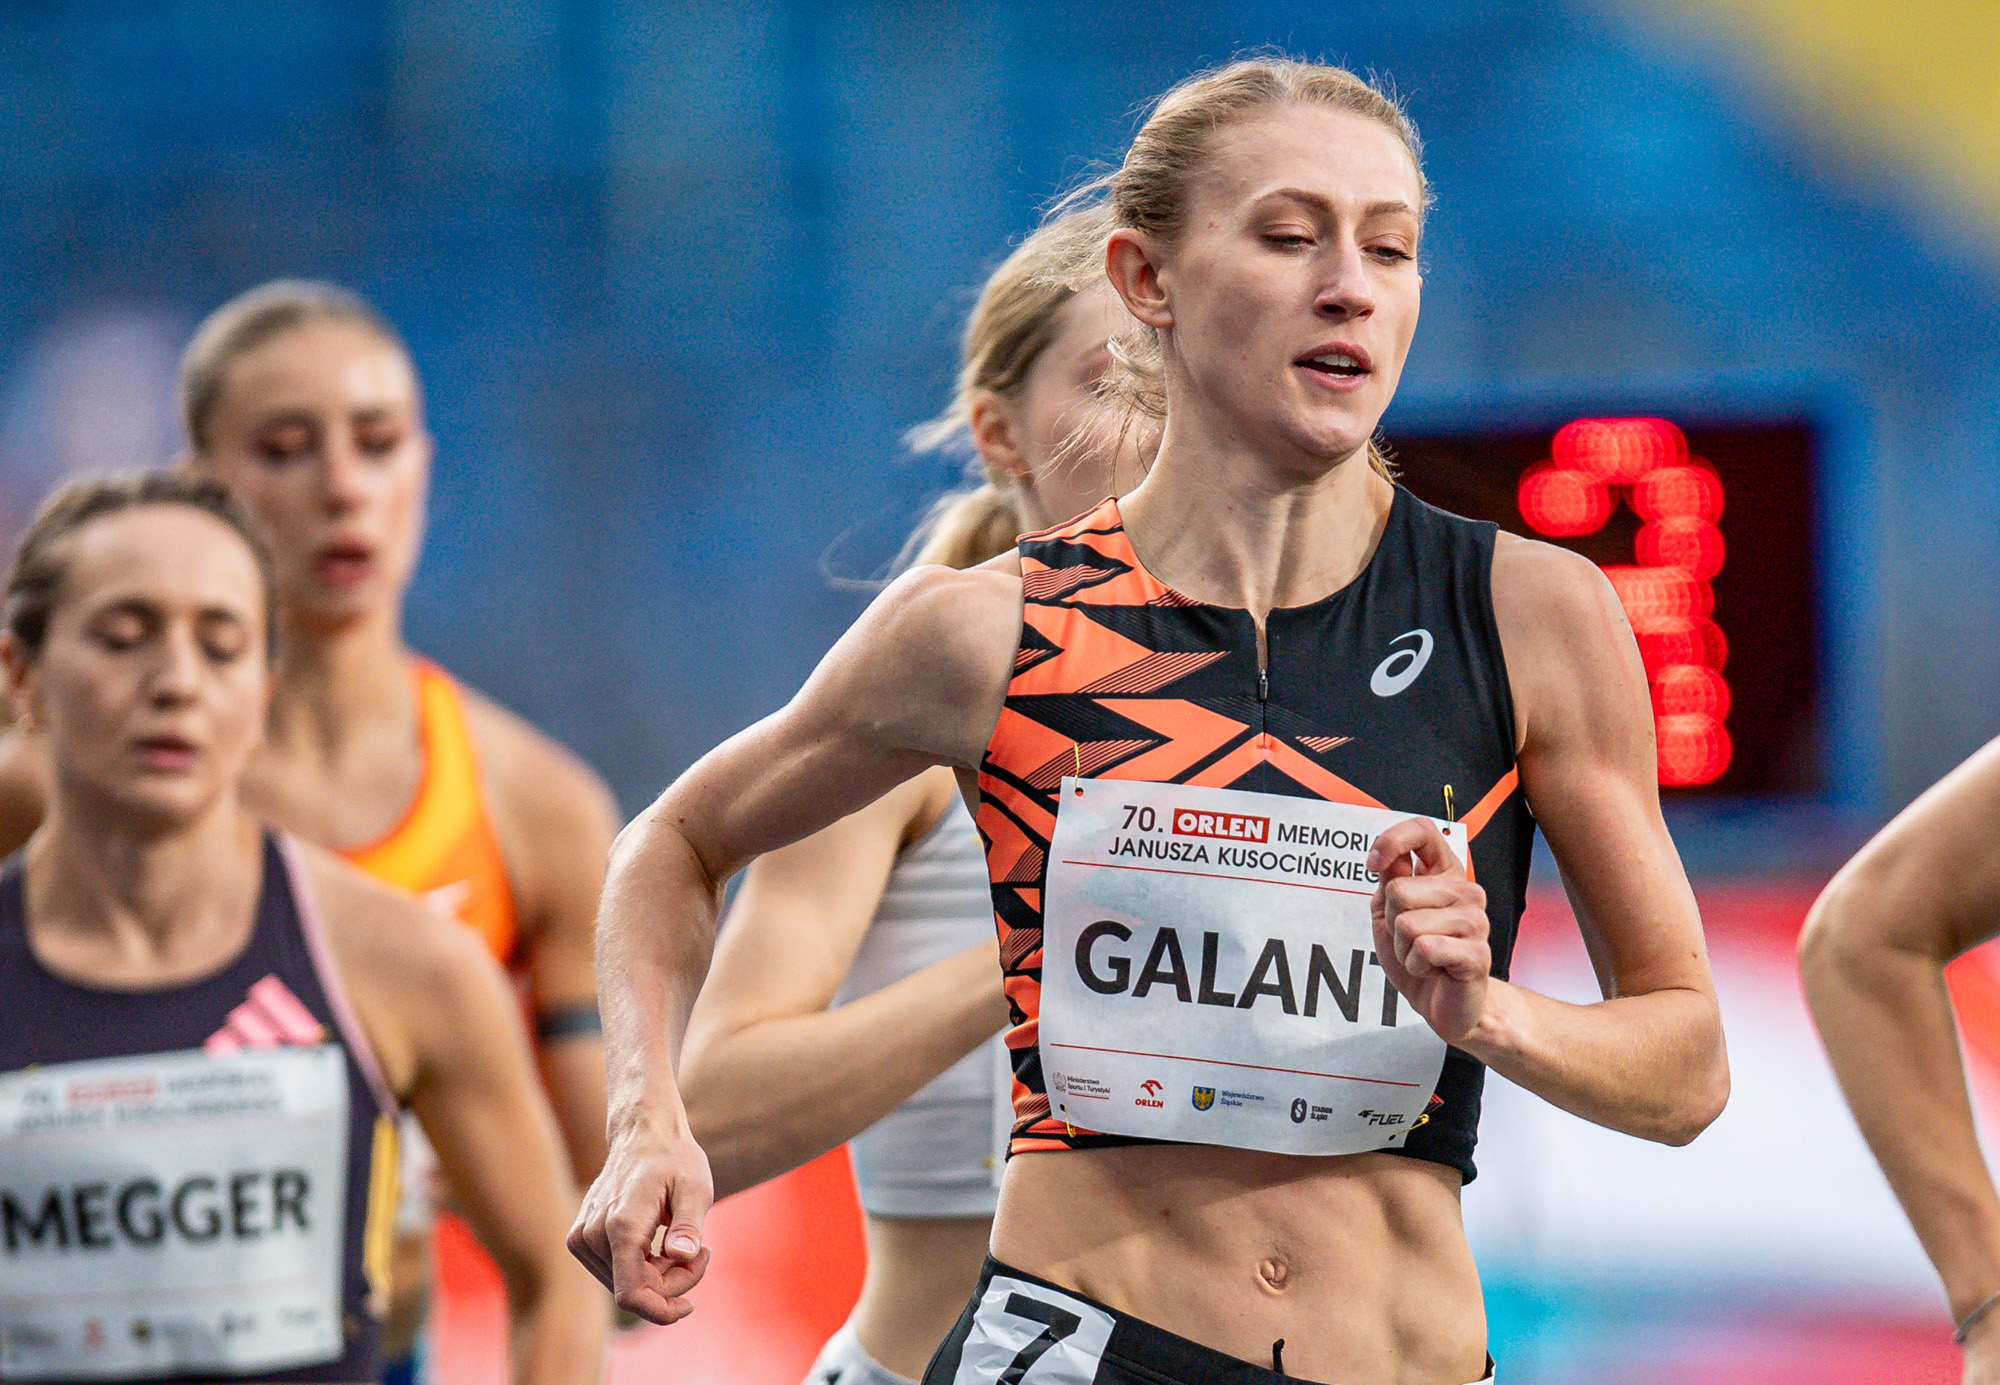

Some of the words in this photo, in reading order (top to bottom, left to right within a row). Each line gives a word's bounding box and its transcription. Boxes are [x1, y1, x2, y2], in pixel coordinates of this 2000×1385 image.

[1121, 804, 1163, 833] 70.
[1176, 812, 1264, 840] ORLEN
[1277, 822, 1378, 853] MEMORI
[1108, 836, 1210, 864] JANUSZA
[1217, 846, 1380, 884] KUSOCIŃSKIEG
[1074, 920, 1398, 1027] GALANT
[1067, 1083, 1083, 1092] Sportu
[1135, 1098, 1164, 1108] ORLEN
[1368, 1113, 1405, 1125] FUEL
[0, 1165, 314, 1254] MEGGER
[996, 1292, 1082, 1385] 7
